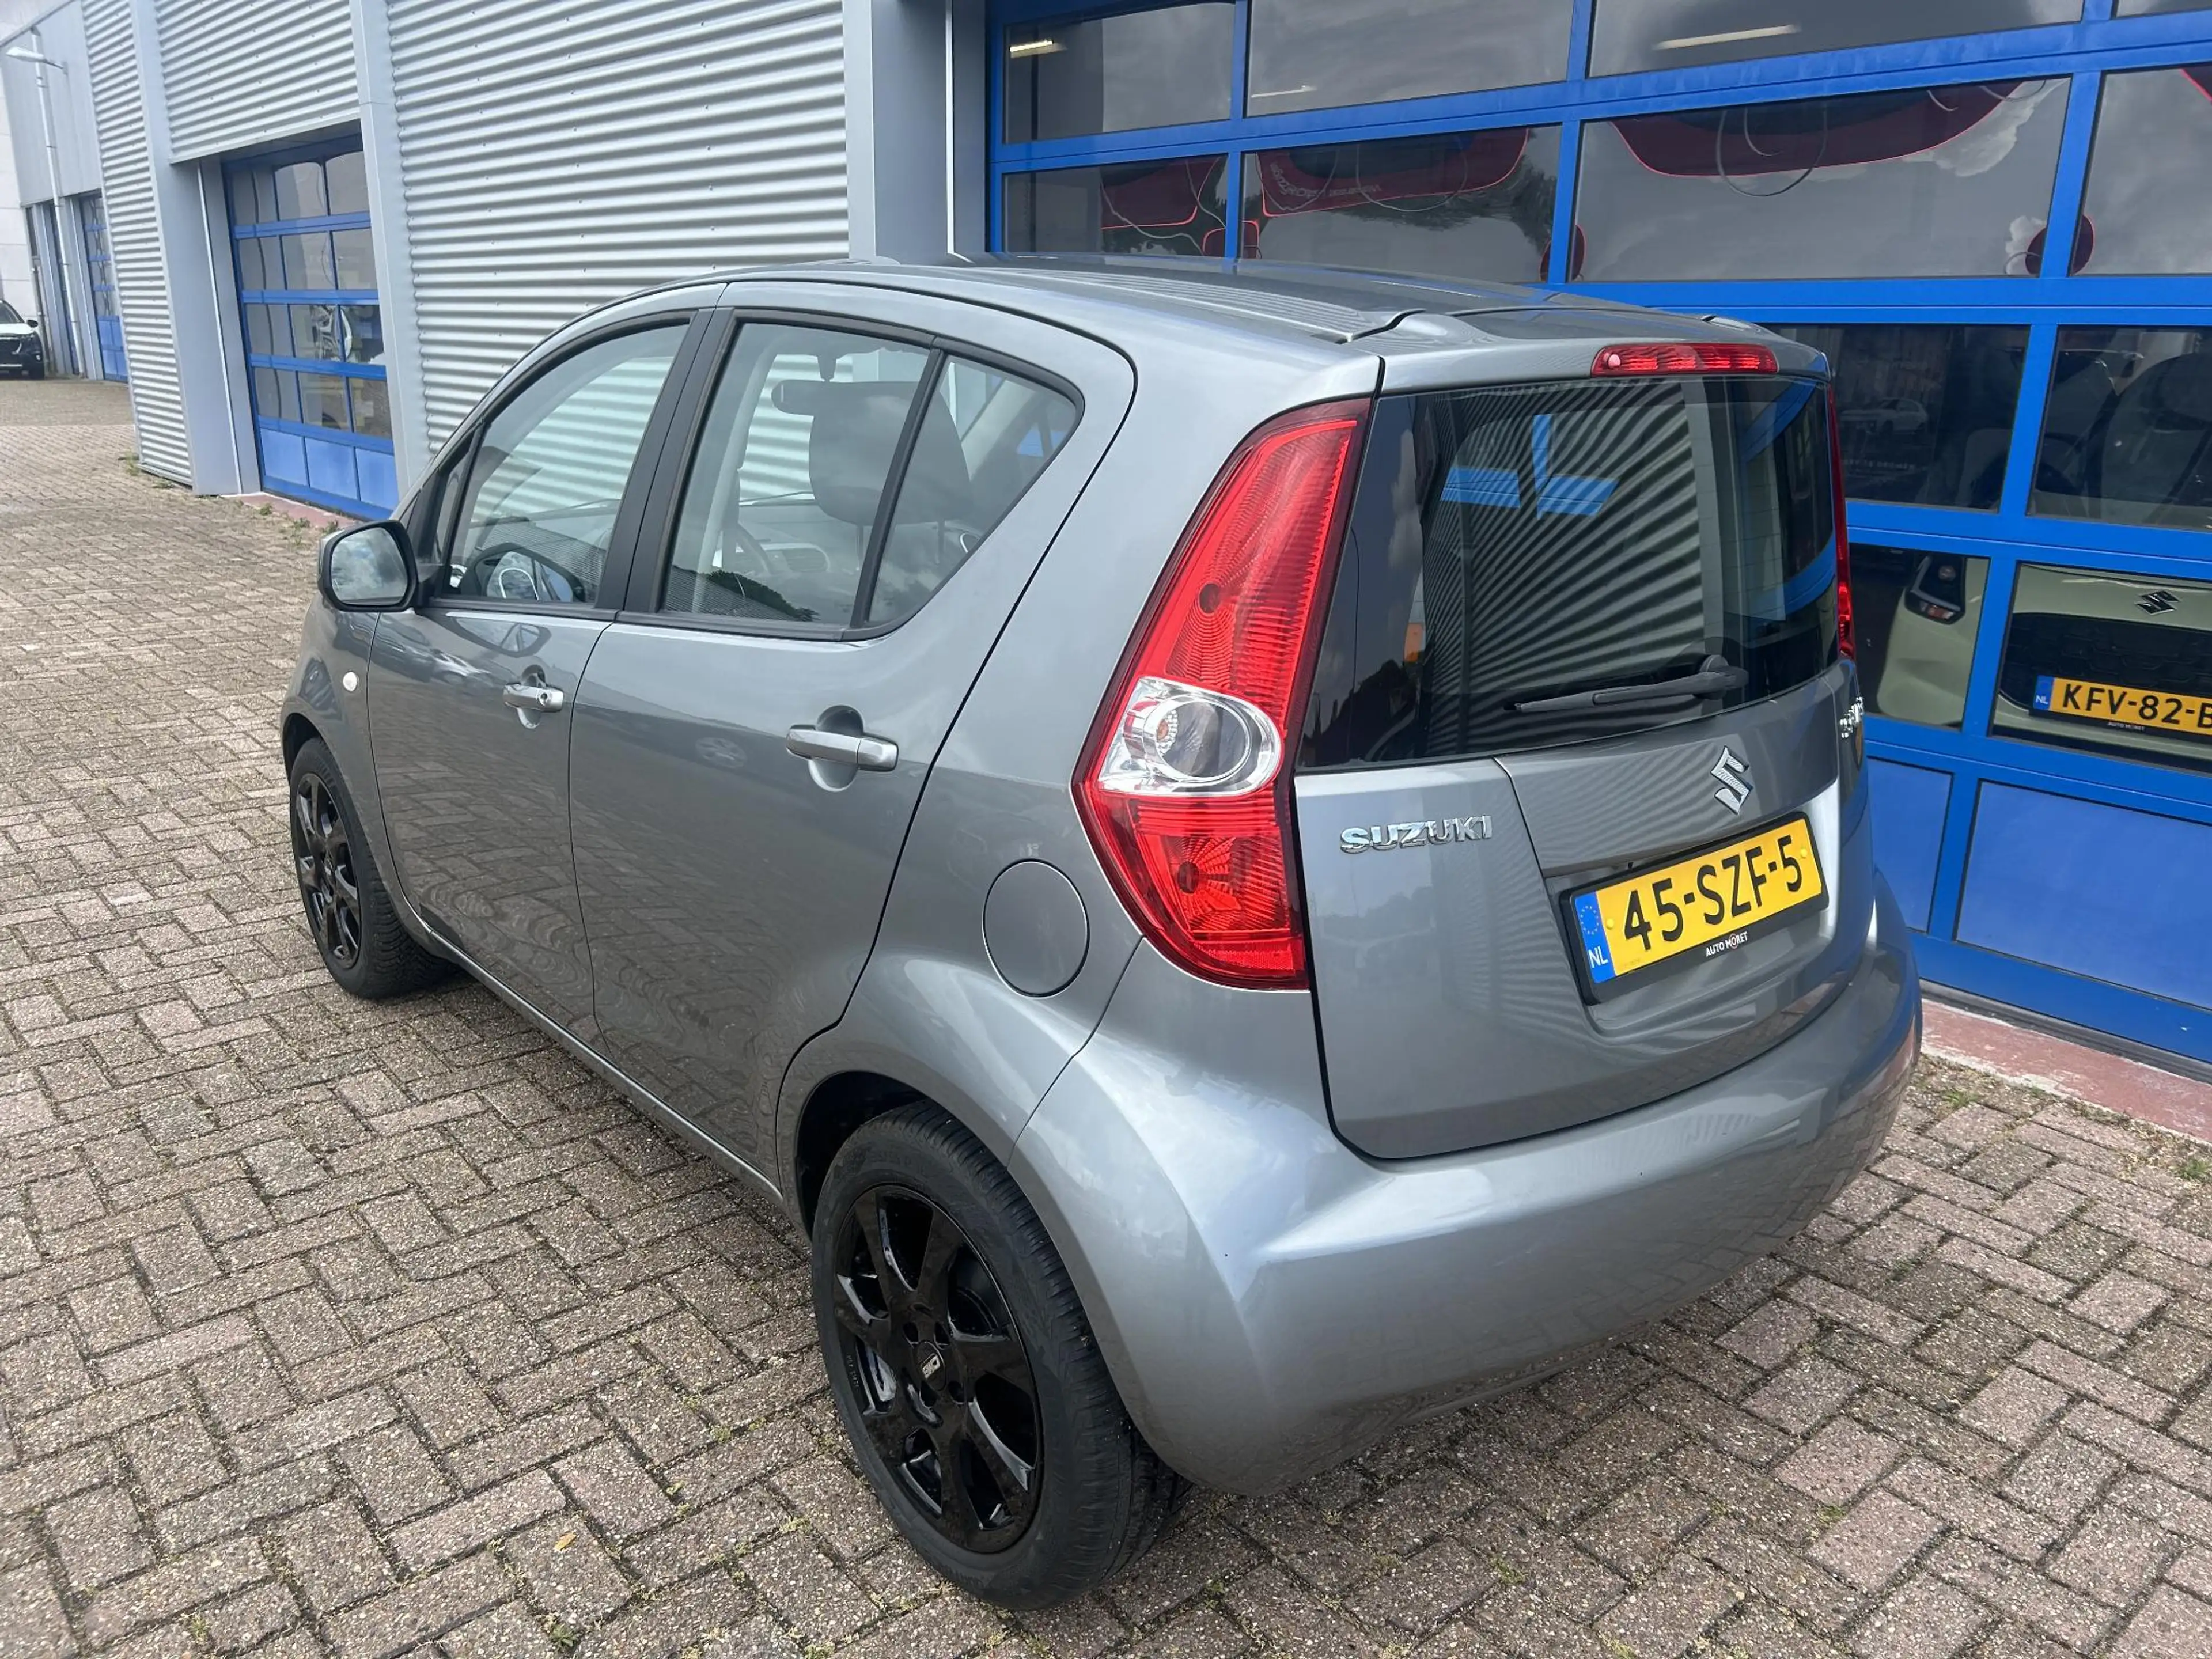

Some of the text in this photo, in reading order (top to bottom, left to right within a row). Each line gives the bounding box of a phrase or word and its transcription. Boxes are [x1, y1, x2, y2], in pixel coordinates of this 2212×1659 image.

[2035, 695, 2049, 705] NL
[2062, 683, 2212, 729] KFV-82-B
[1340, 815, 1493, 853] SUZUKI
[1624, 835, 1802, 950] 45-SZF-5
[1588, 945, 1609, 968] NL
[1705, 931, 1748, 957] AUTO MORET
